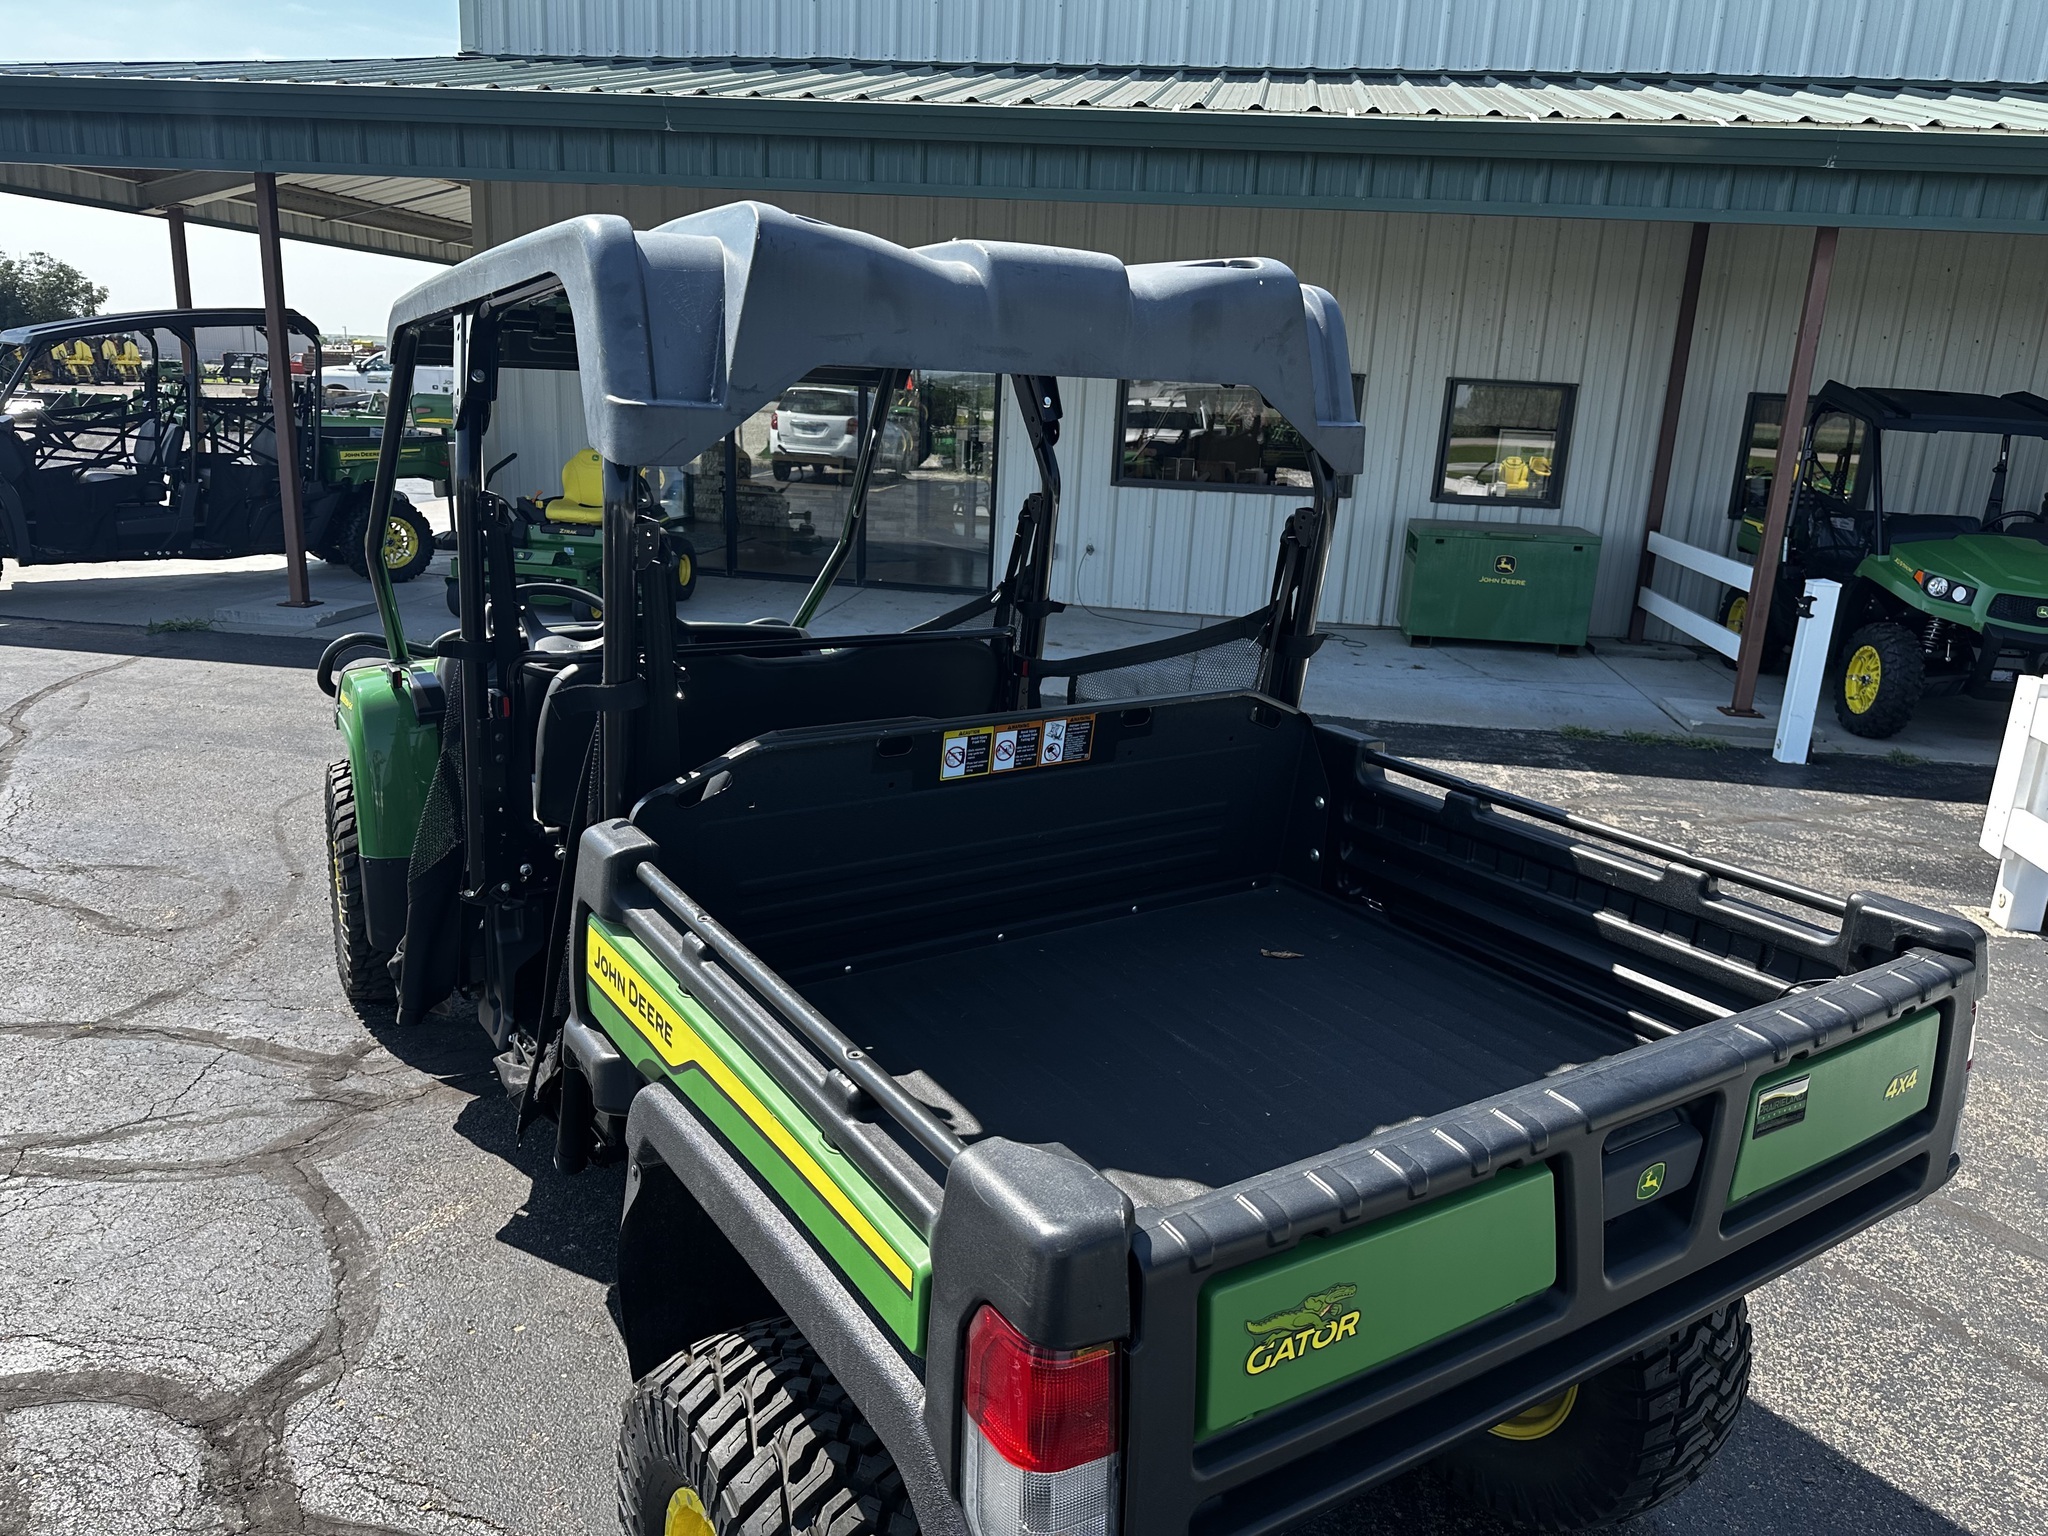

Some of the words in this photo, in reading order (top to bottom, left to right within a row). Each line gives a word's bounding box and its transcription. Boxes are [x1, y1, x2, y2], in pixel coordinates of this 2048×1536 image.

[1479, 576, 1500, 584] JOHN
[1500, 577, 1526, 586] DEERE
[594, 946, 626, 998] JOHN
[628, 978, 673, 1049] DEERE
[1246, 1310, 1360, 1375] GATOR
